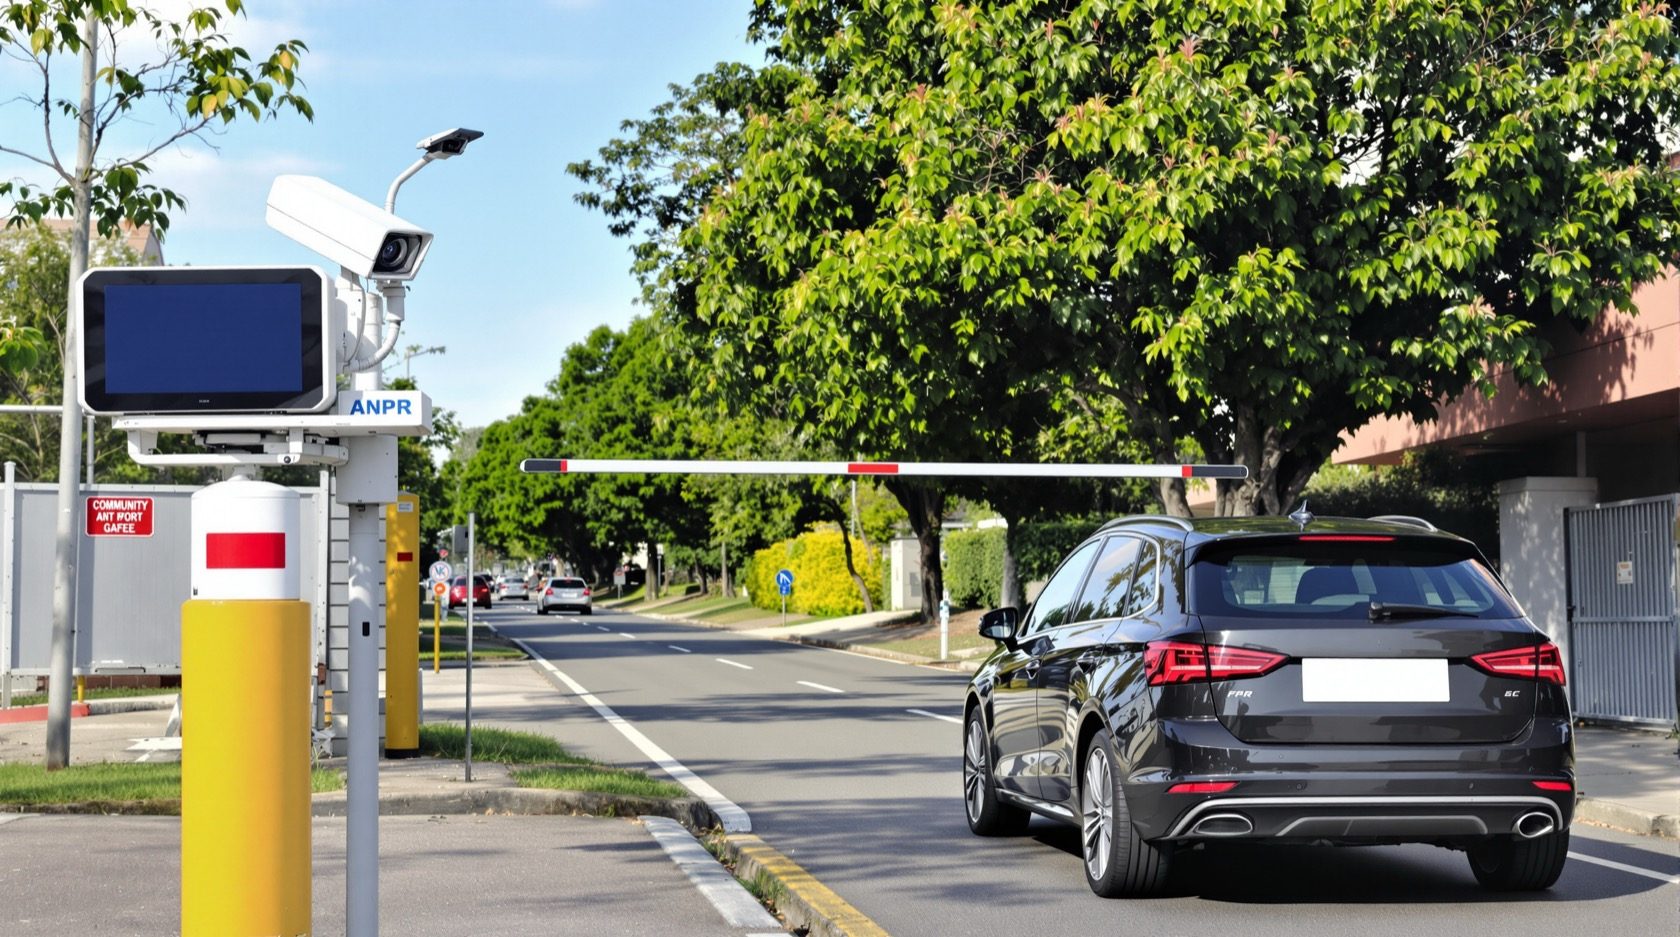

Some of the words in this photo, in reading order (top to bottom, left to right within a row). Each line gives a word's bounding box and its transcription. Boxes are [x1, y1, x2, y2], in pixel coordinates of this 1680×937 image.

[350, 399, 412, 415] ANPR
[92, 499, 149, 511] COMMUNITY
[95, 511, 115, 522] ANT
